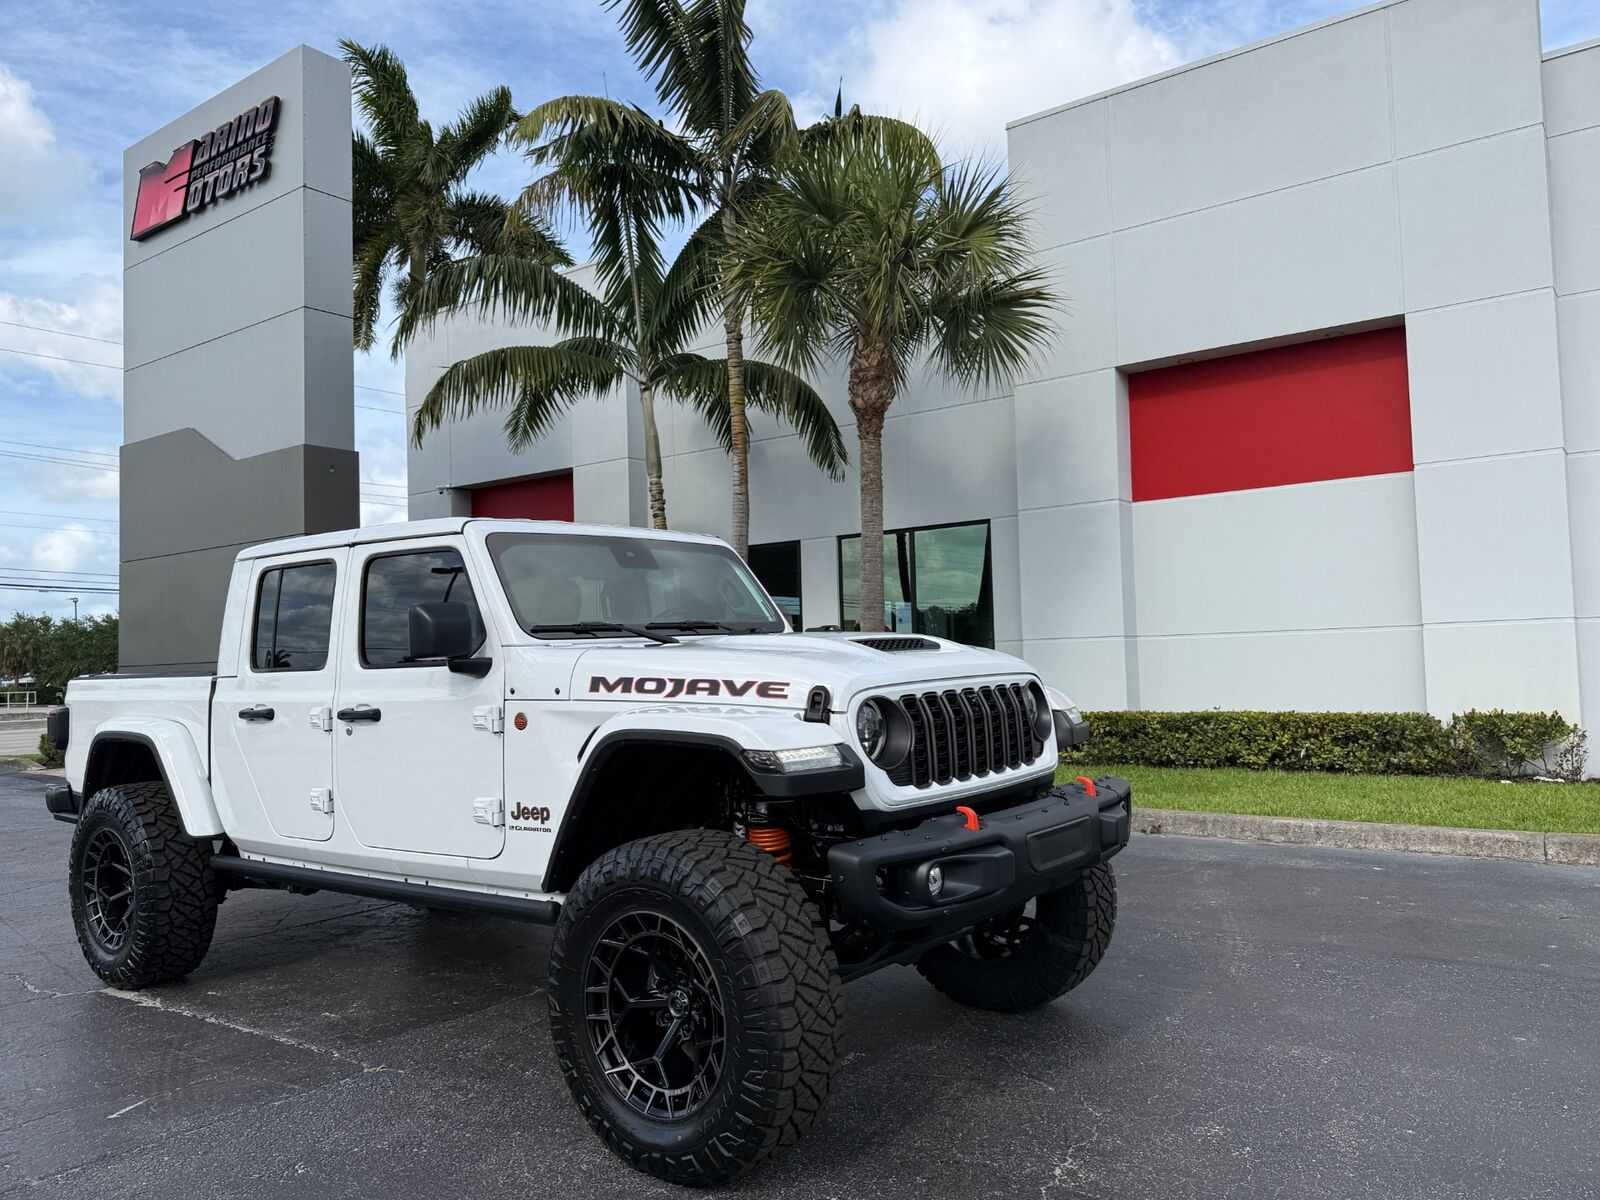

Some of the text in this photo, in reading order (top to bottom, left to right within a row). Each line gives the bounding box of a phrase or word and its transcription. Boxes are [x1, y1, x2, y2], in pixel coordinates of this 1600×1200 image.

[588, 675, 791, 699] MOJAVE
[510, 801, 551, 825] Jeep
[515, 825, 552, 834] GLADIATOR
